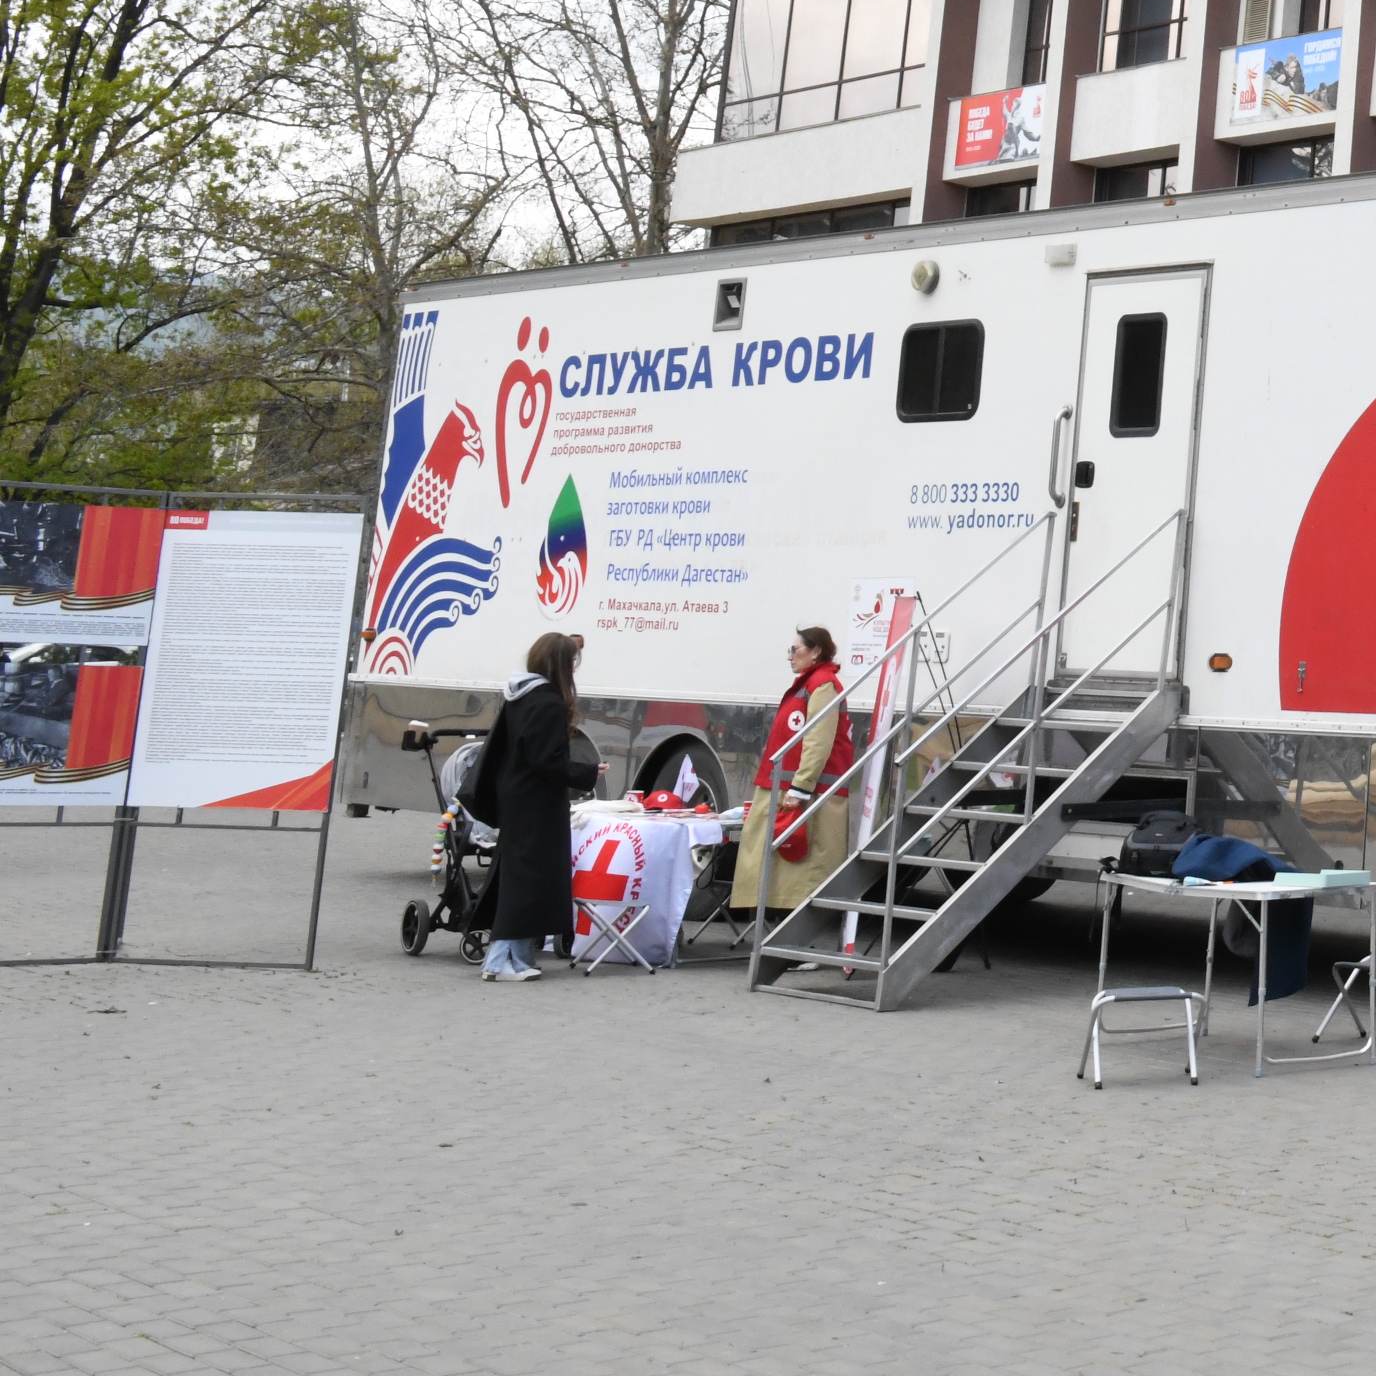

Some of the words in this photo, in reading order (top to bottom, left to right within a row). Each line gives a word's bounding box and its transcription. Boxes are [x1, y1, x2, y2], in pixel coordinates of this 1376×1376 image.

[559, 345, 713, 399] СЛУЖБА
[731, 331, 875, 387] КРОВИ
[555, 406, 637, 423] государственная
[553, 425, 605, 441] программа
[607, 423, 654, 438] развития
[550, 442, 626, 457] добровольного
[628, 439, 682, 455] донорства
[609, 467, 683, 489] Мобильный
[685, 469, 748, 485] комплекс
[910, 484, 918, 504] 8
[921, 484, 947, 504] 800
[950, 483, 978, 503] 333
[982, 482, 1020, 502] 3330
[606, 501, 669, 516] заготовки
[672, 500, 711, 519] крови
[609, 529, 632, 547] ГБУ
[636, 529, 654, 552] РД
[656, 529, 702, 552] «Центр
[705, 533, 746, 553] крови
[606, 563, 679, 587] Республики
[681, 564, 749, 587] Дагестан»
[598, 601, 605, 611] г.
[682, 600, 720, 613] Атаева
[723, 601, 729, 613] 3
[596, 616, 679, 633] rspk_77@mail.ru
[613, 822, 647, 872] КРАСНЫЙ
